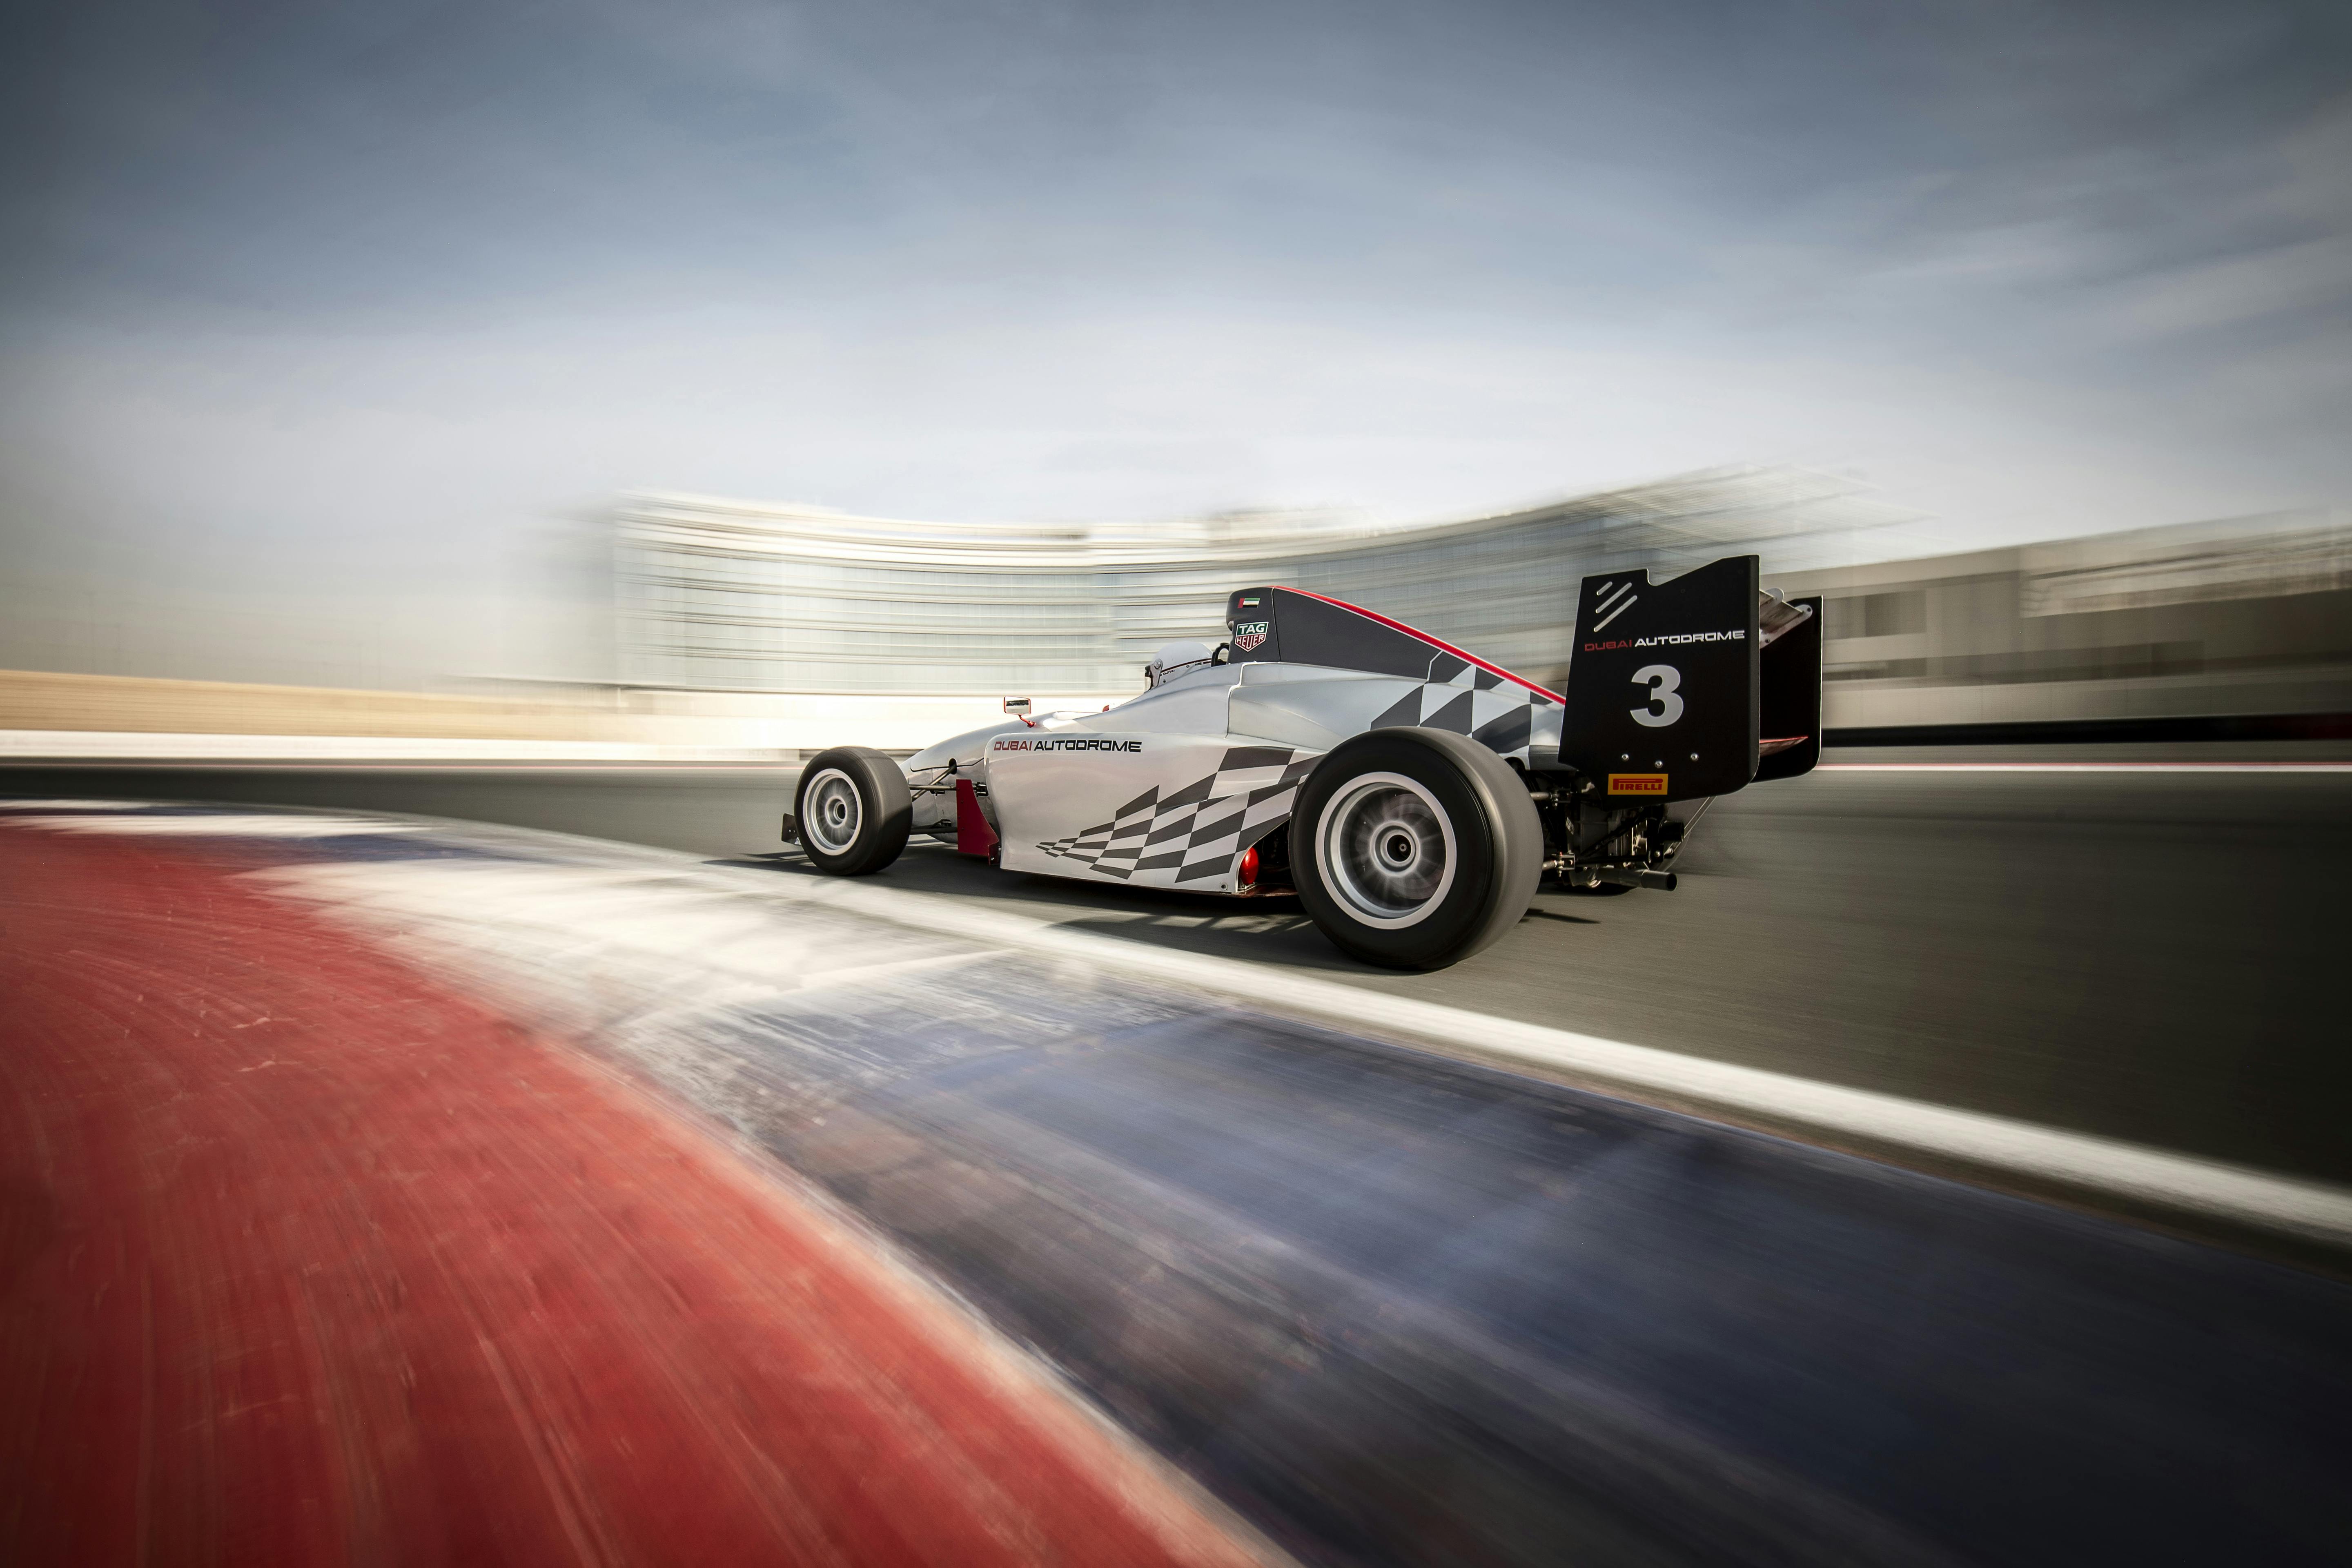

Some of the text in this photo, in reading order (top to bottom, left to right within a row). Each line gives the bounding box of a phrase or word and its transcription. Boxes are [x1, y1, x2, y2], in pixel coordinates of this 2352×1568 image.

[1239, 624, 1265, 634] TAG
[1236, 635, 1264, 650] HEUER
[1585, 629, 1745, 651] DUBAI AUTODROME
[1630, 664, 1684, 727] 3
[993, 739, 1142, 753] DUBAI AUTODROME
[1613, 778, 1663, 791] PIRELLI
